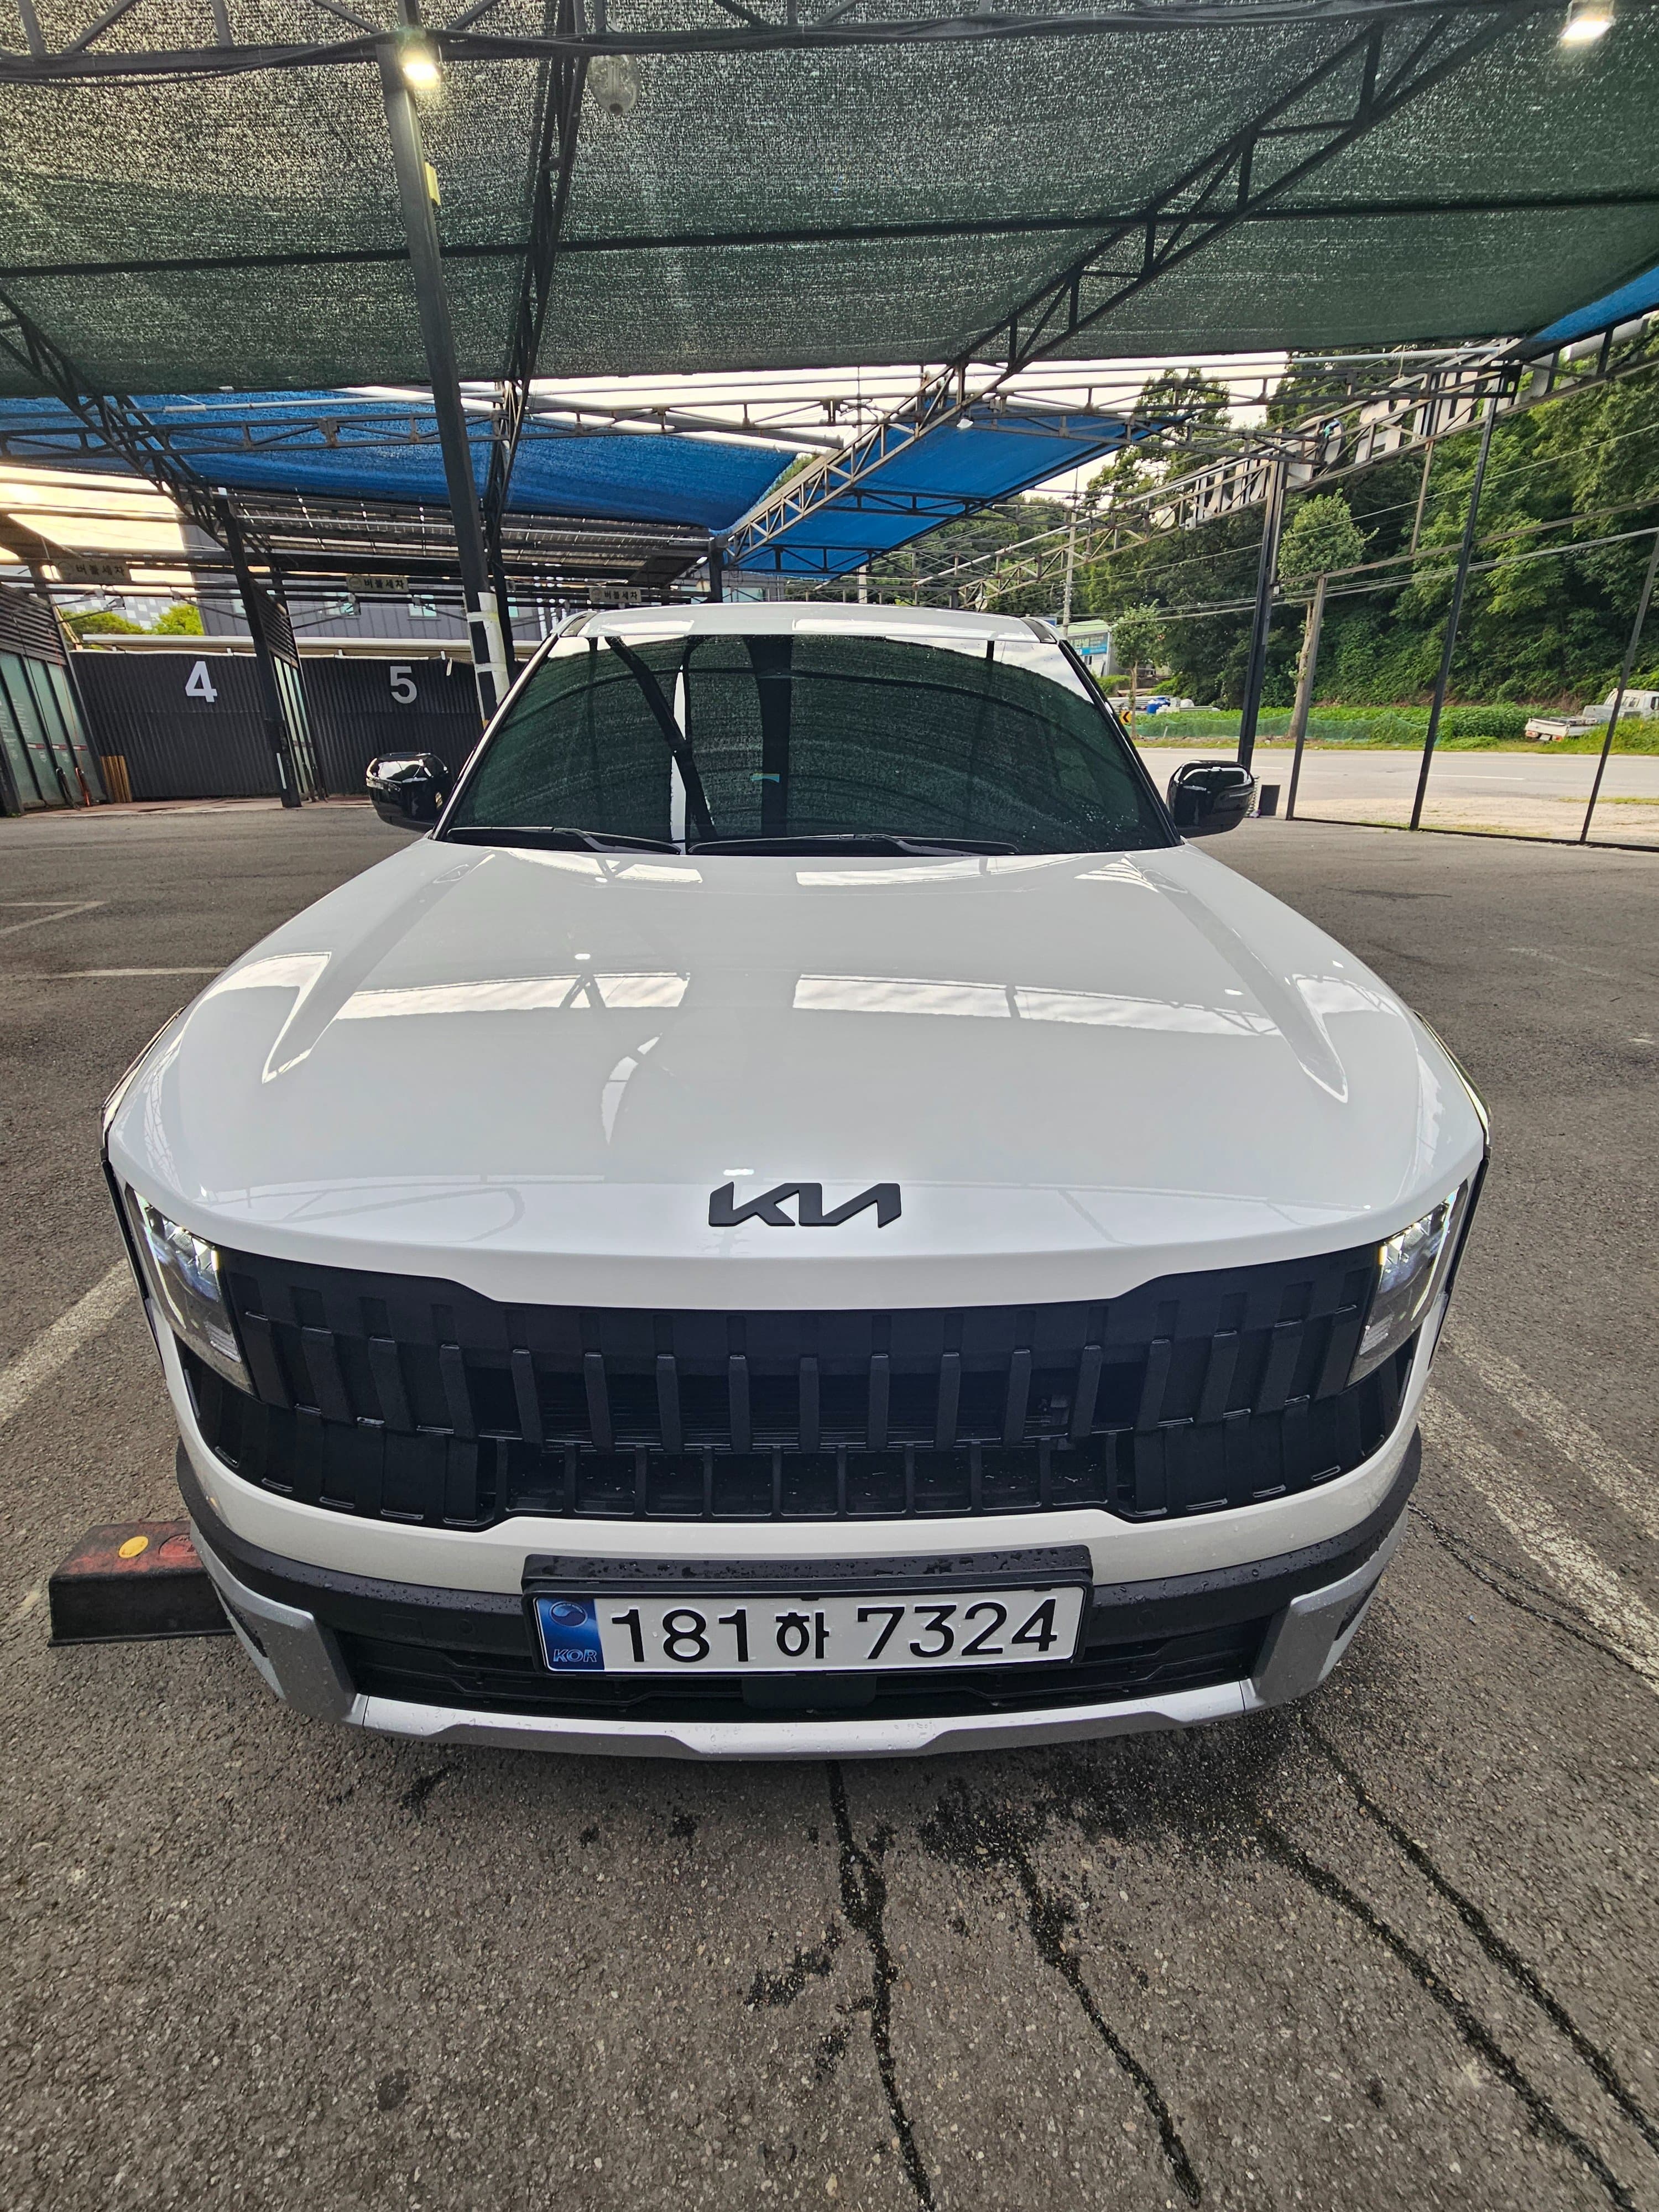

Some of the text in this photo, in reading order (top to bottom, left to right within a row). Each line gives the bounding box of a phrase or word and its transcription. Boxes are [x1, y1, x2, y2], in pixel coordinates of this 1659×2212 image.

[185, 661, 217, 702] 4
[390, 666, 417, 704] 5
[611, 1598, 1058, 1662] 181하 7324
[553, 1649, 597, 1662] KOR
